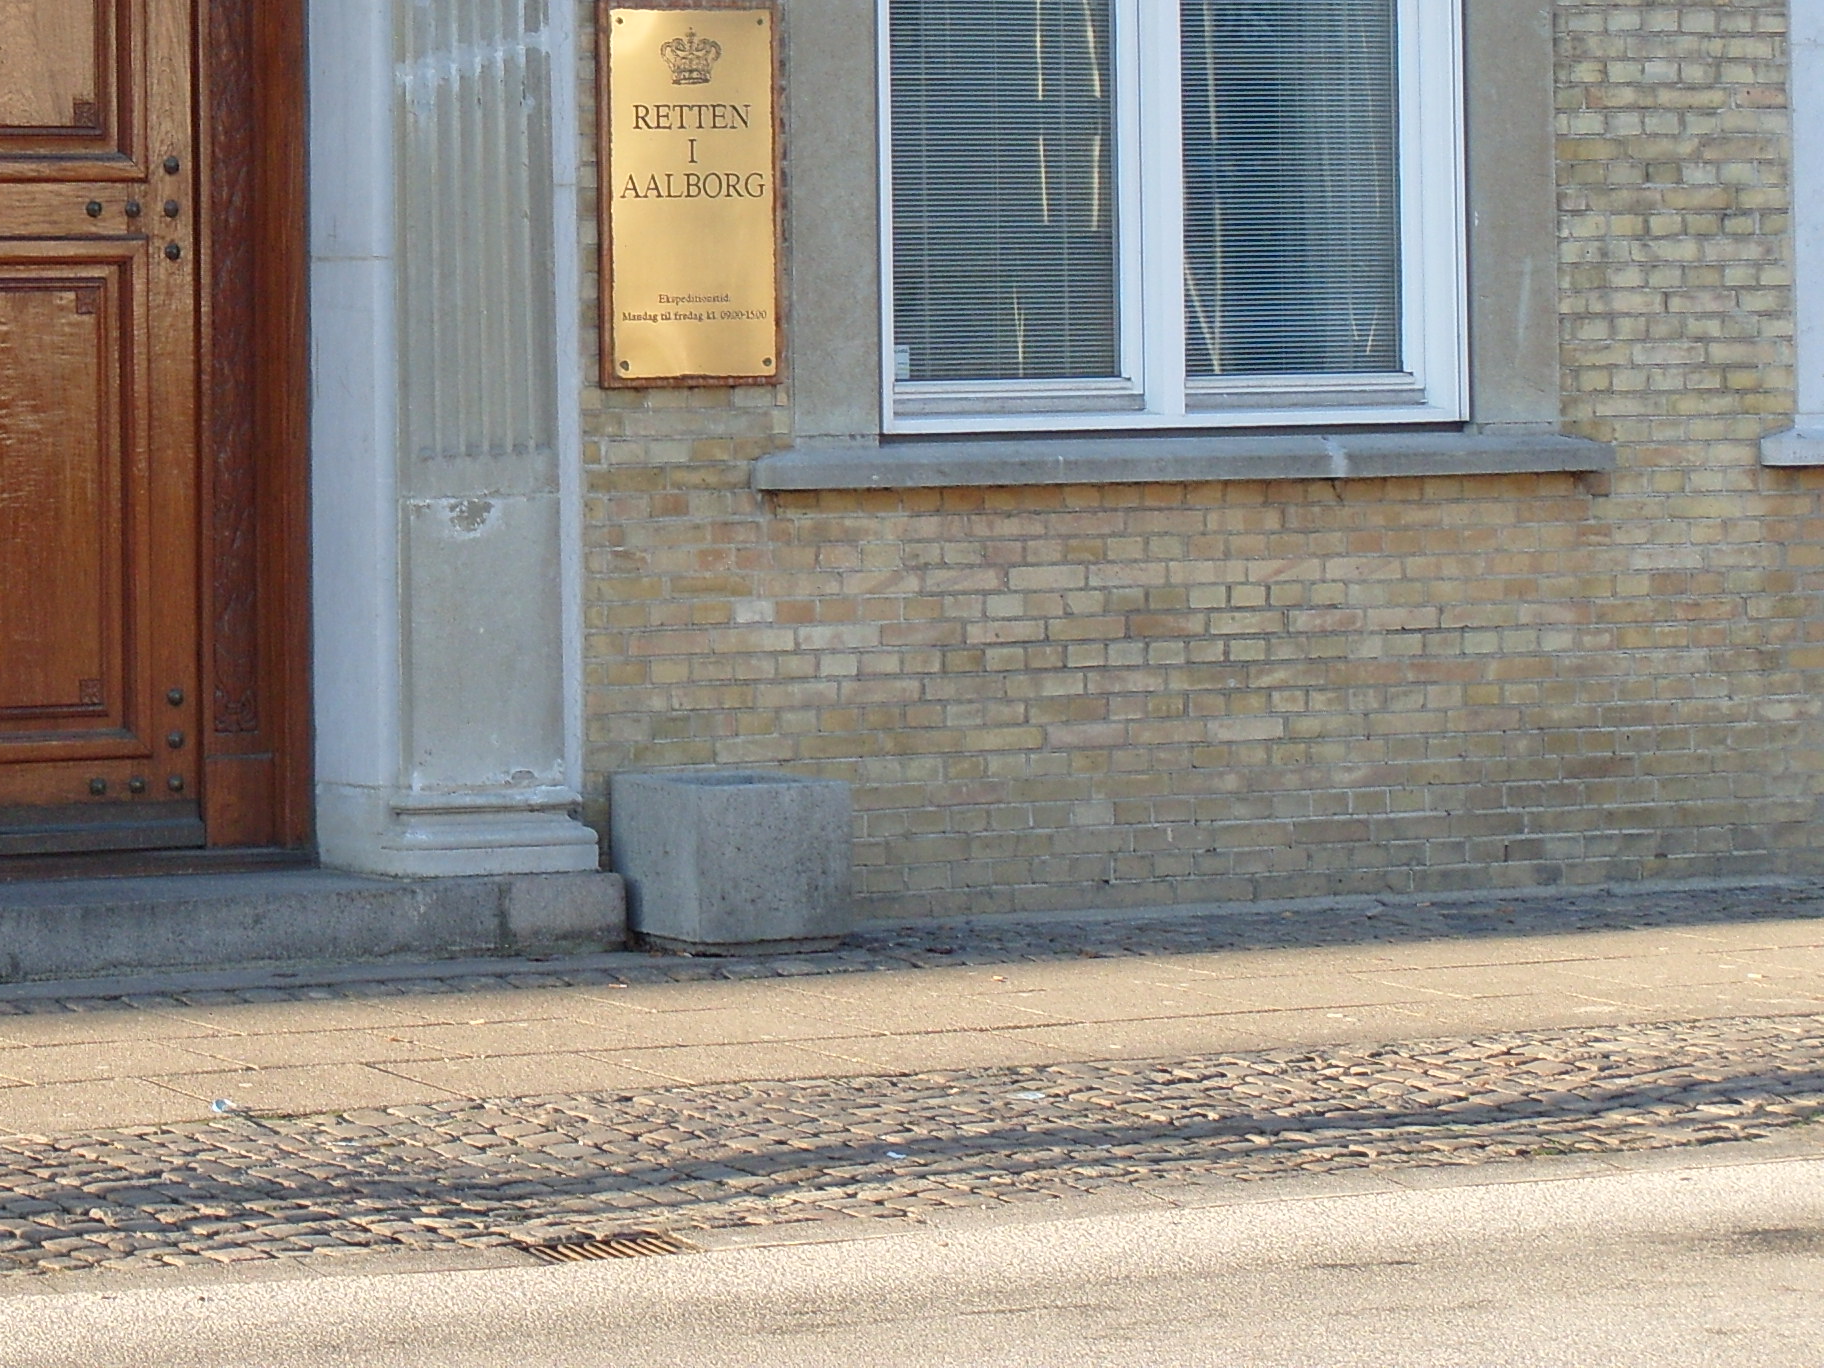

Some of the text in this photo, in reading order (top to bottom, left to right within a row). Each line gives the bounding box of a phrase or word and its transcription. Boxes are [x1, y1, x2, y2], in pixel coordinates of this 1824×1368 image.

[632, 103, 752, 130] RETTEN
[687, 138, 698, 164] I
[619, 172, 766, 199] AALBORG
[622, 311, 659, 324] Mandag
[660, 311, 671, 321] til
[674, 310, 704, 323] fredag
